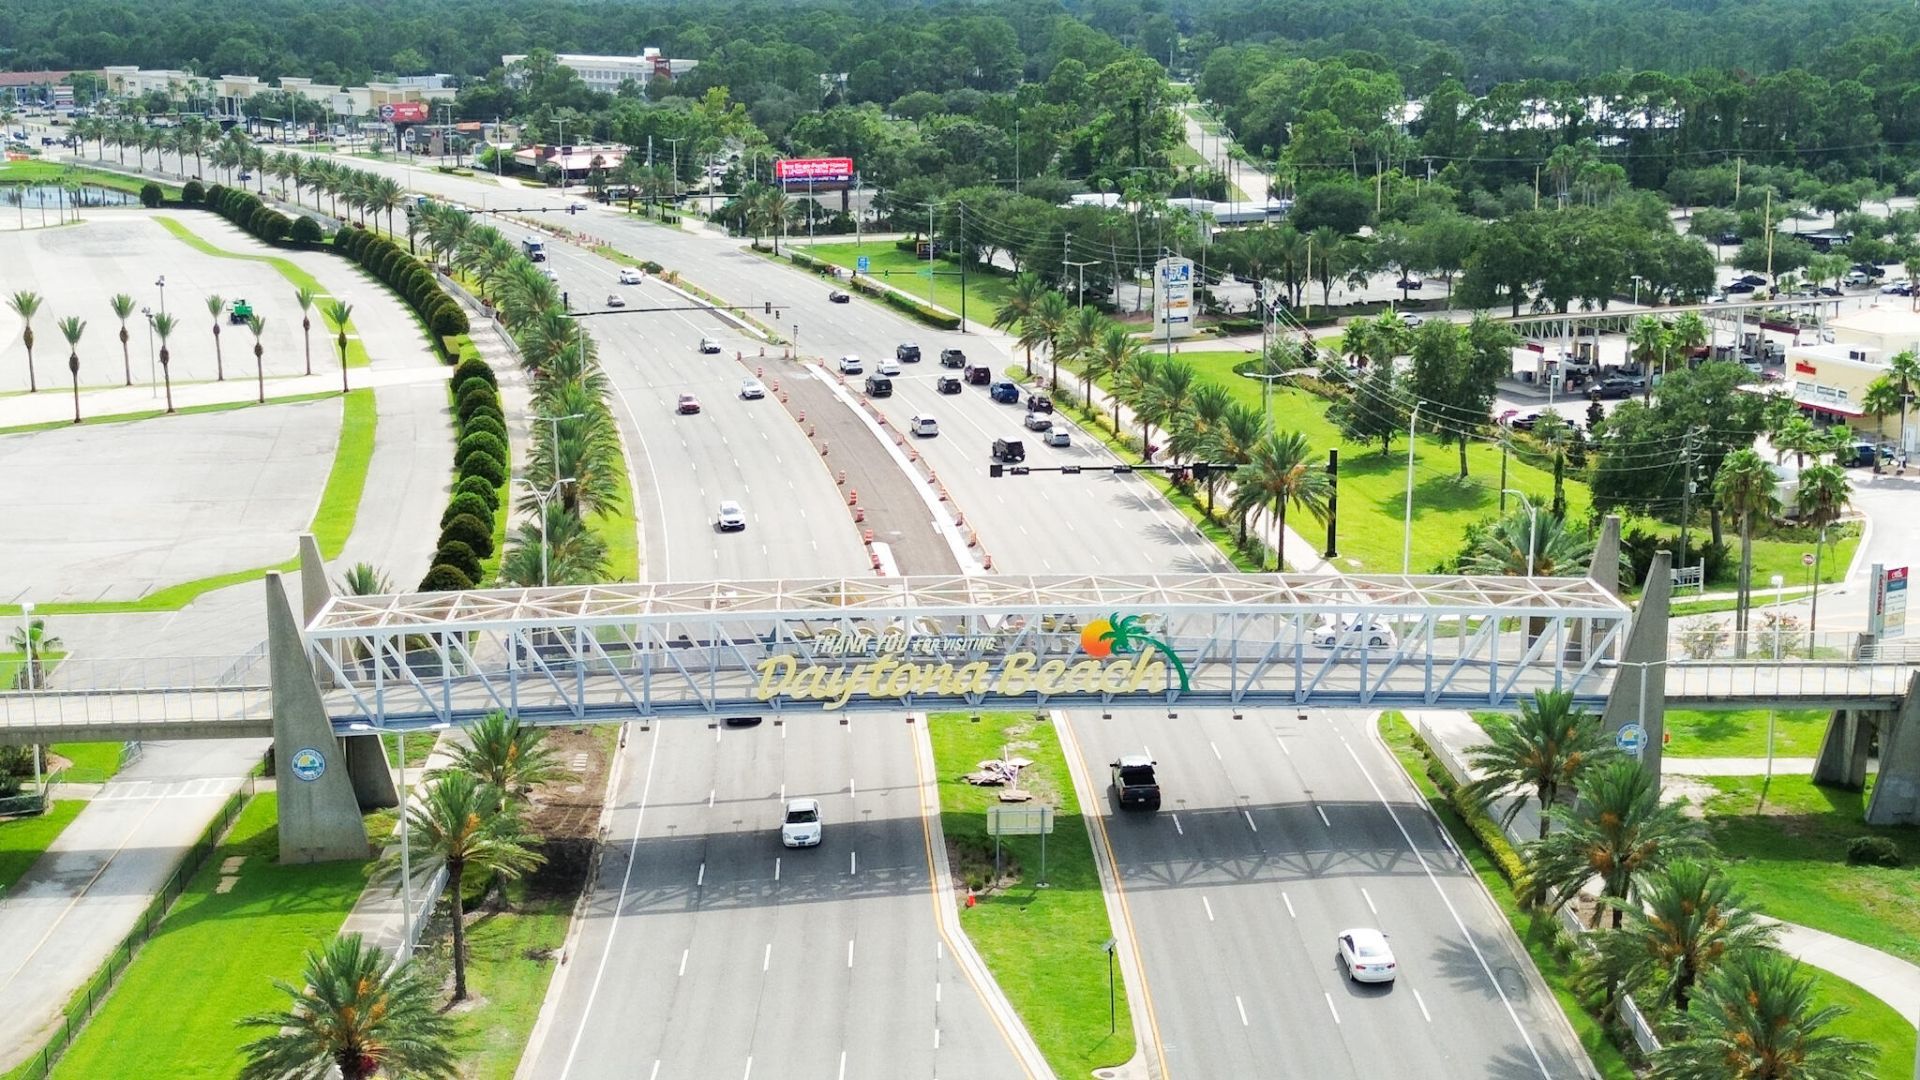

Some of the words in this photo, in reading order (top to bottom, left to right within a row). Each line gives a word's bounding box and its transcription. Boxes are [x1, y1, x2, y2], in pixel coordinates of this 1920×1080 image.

[812, 634, 868, 654] THANK
[875, 633, 910, 653] YOU
[913, 637, 940, 651] FOR
[943, 637, 997, 651] VISITING
[756, 652, 990, 710] Daytona
[997, 646, 1166, 695] Beach
